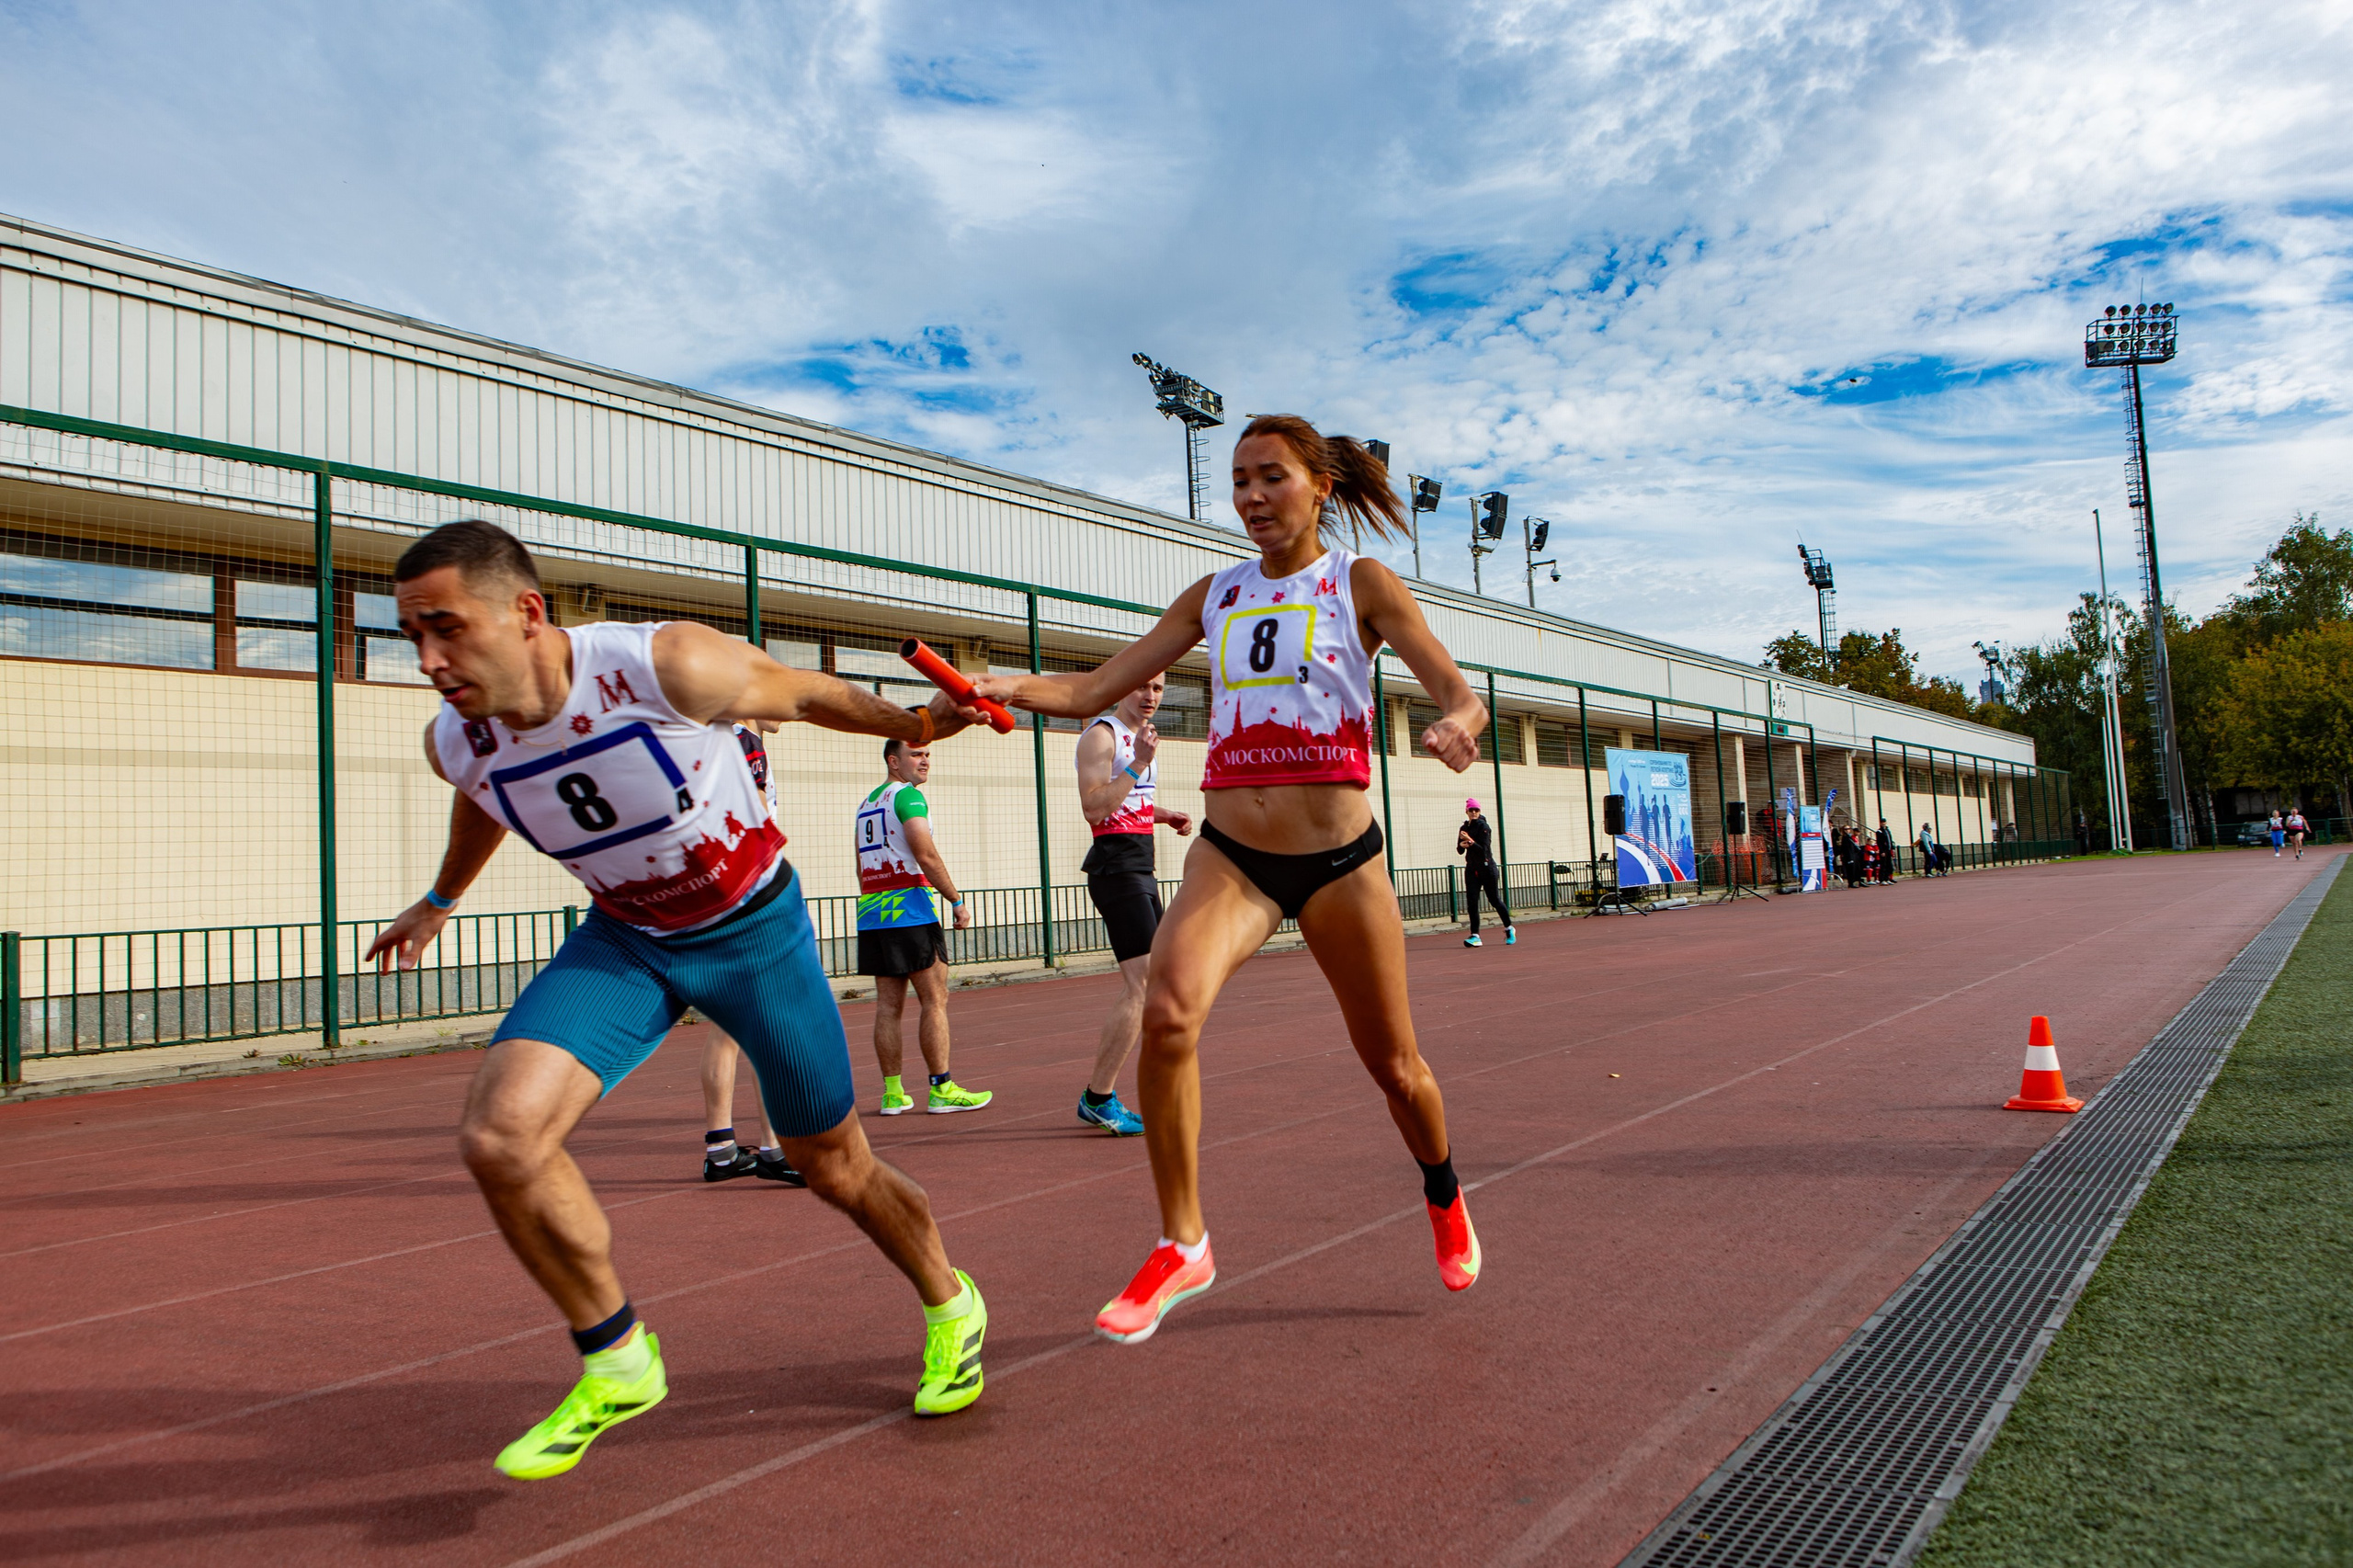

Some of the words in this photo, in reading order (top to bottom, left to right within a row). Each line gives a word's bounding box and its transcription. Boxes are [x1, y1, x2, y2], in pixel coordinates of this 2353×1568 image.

[1248, 618, 1279, 674] 8
[592, 668, 642, 714] М
[1298, 665, 1309, 685] 3
[1223, 745, 1358, 766] МОСКОМСПОРТ
[558, 773, 619, 832] 8
[865, 819, 873, 844] 9
